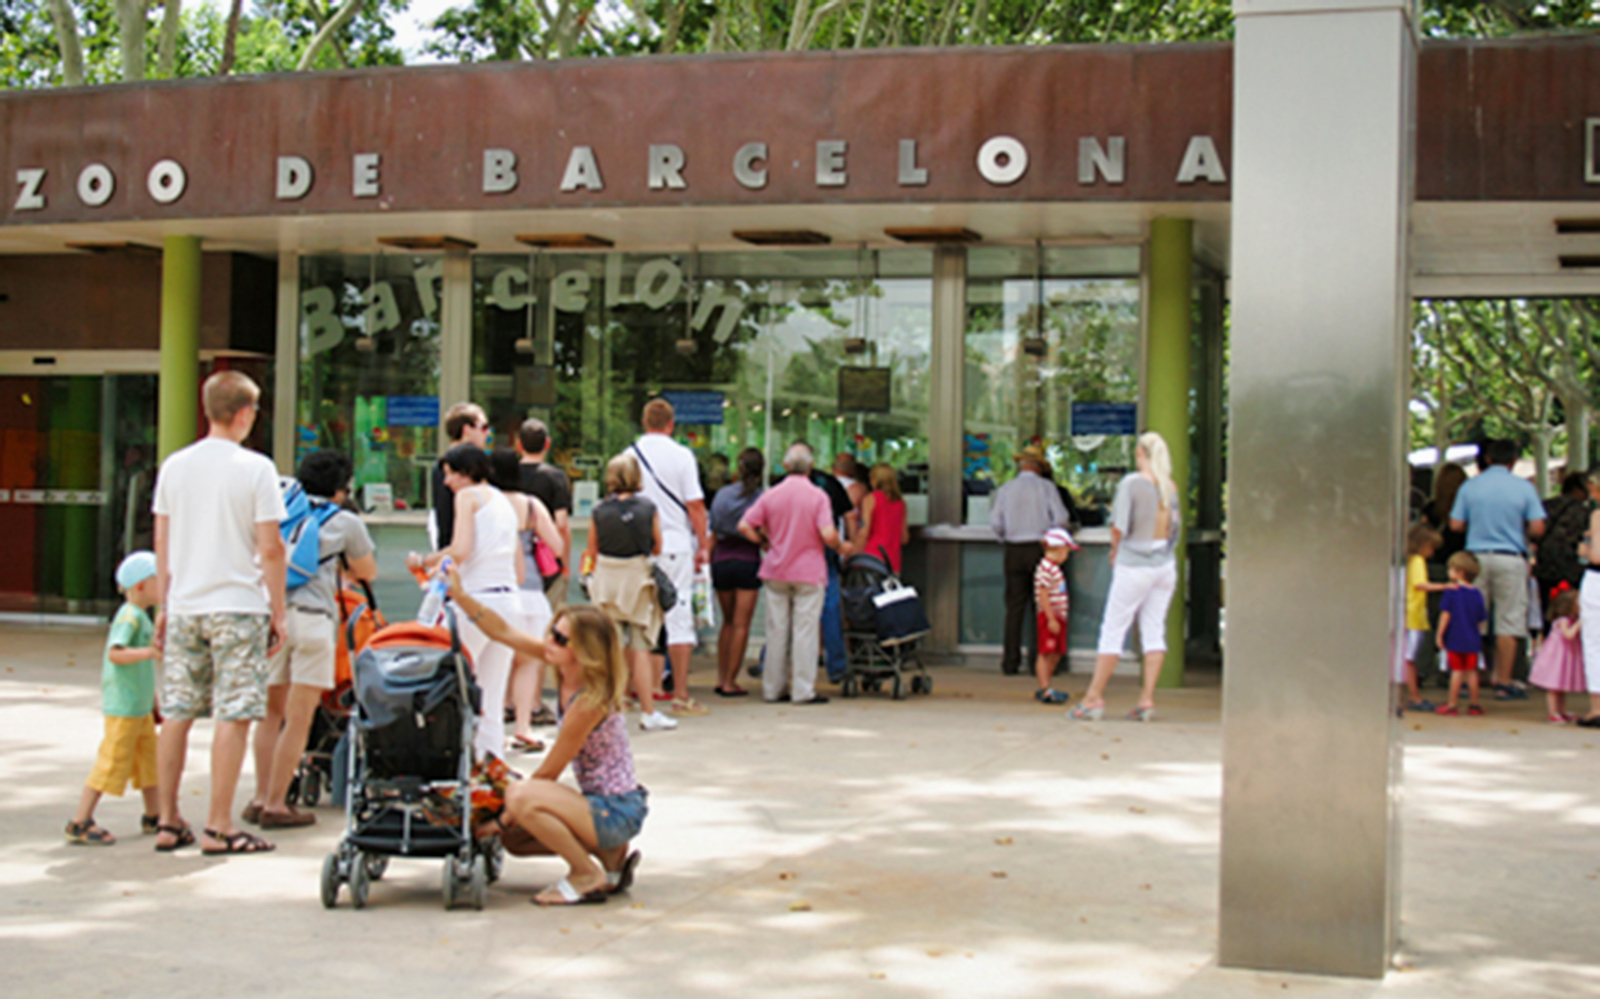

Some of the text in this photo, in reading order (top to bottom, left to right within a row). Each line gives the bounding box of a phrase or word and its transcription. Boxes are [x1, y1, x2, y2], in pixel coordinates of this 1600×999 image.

[15, 136, 1226, 208] ZOO DE BARCELONA
